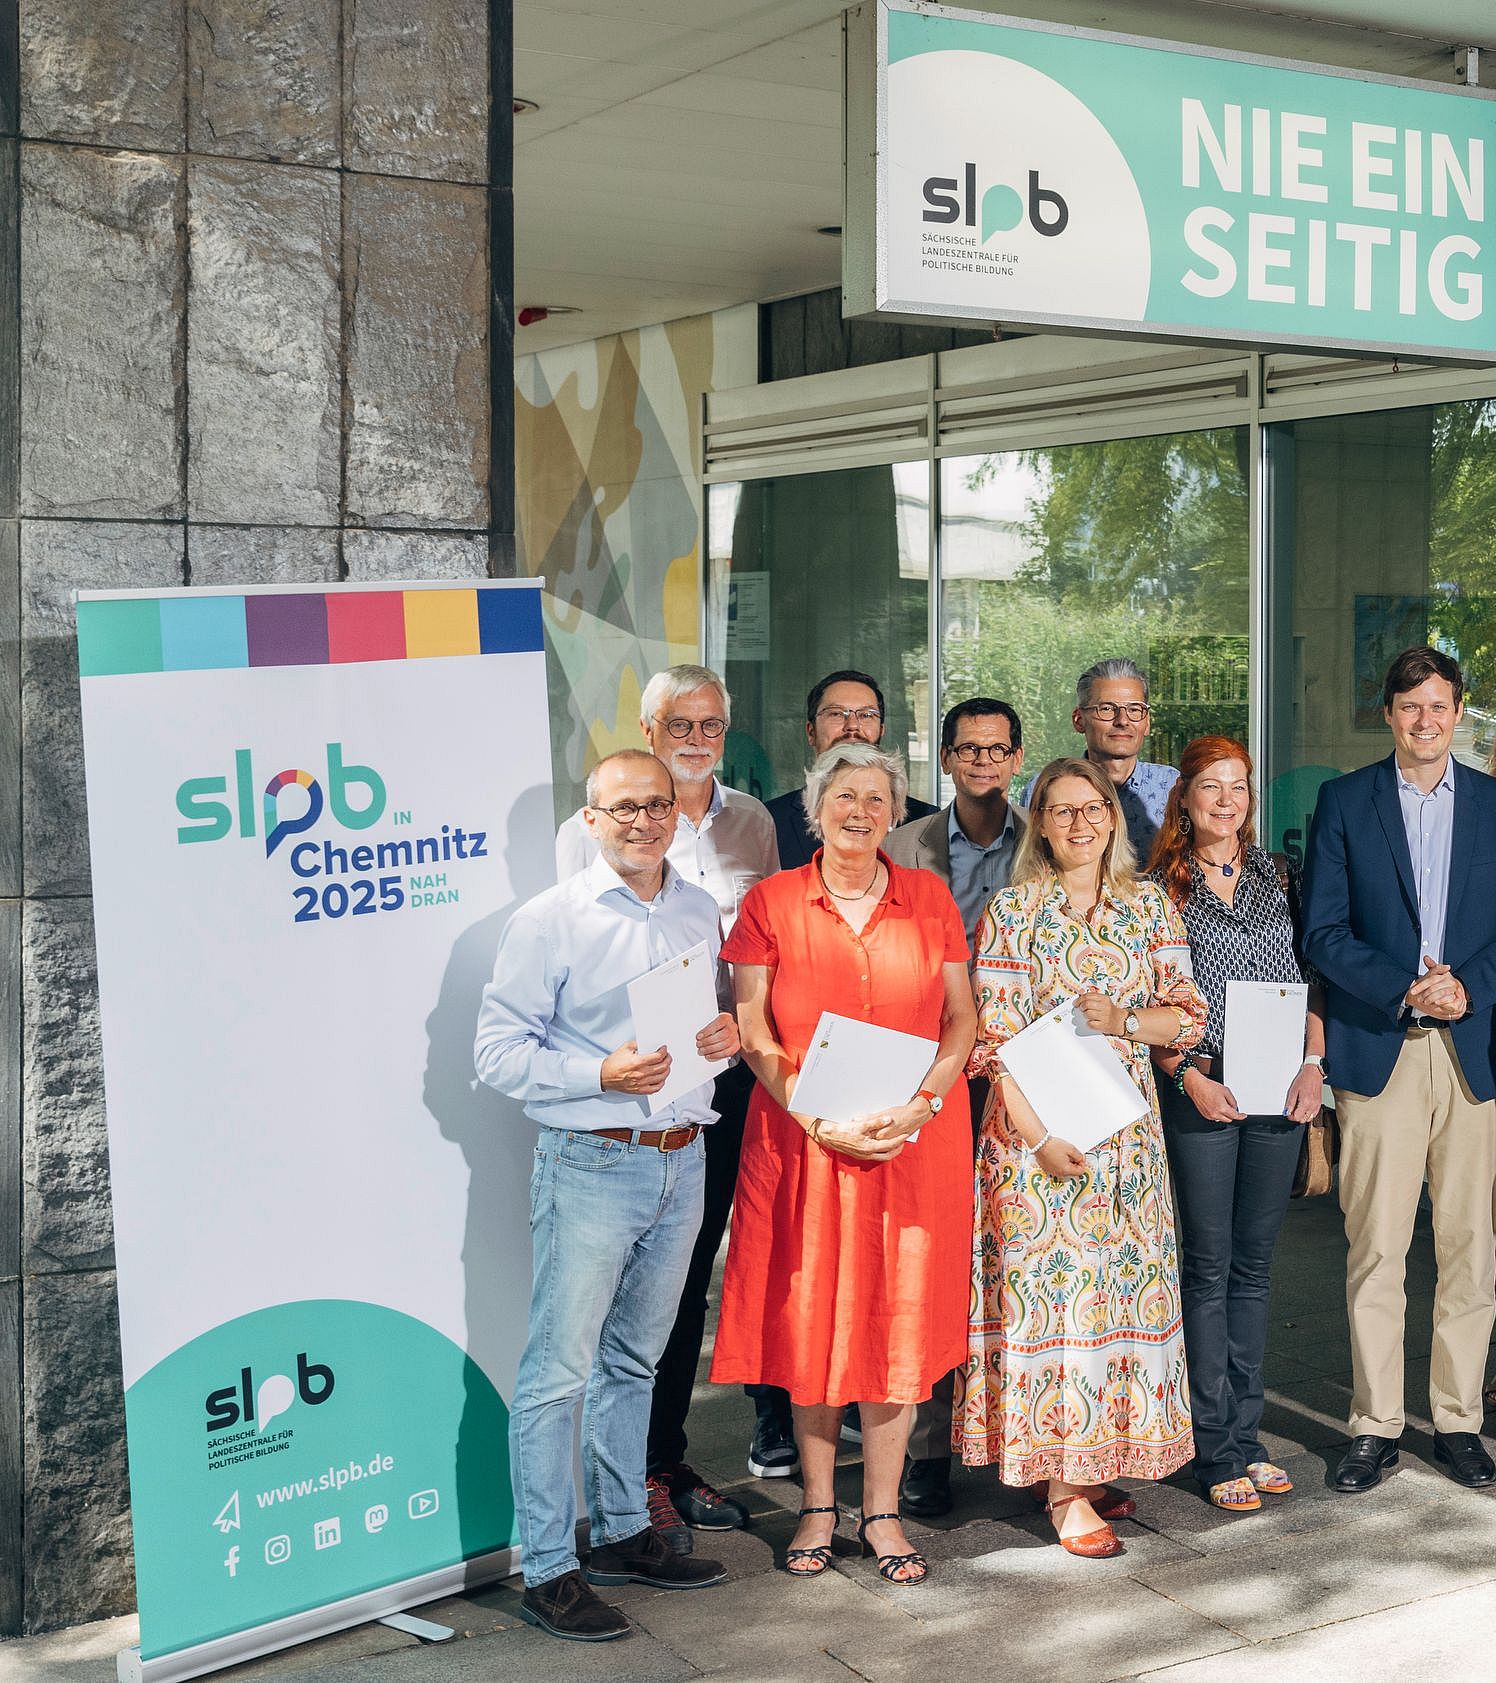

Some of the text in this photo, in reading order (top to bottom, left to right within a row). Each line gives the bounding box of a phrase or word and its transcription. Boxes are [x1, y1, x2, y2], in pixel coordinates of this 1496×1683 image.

[1182, 98, 1484, 222] NIE EIN
[923, 162, 1069, 245] slpb
[922, 233, 977, 247] SÄCHSISCHE
[922, 246, 1019, 264] LANDESZENTRALE FÜR
[922, 259, 1014, 276] POLITISCHE BILDUNG
[1180, 207, 1483, 321] SEITIG
[175, 742, 412, 859] slpb IN
[290, 824, 488, 878] Chemnitz
[293, 875, 405, 923] 2025
[410, 872, 448, 890] NAH
[411, 888, 460, 909] DRAN
[205, 1352, 335, 1433] slpb
[207, 1429, 256, 1449] SÄCHSISCHE
[208, 1429, 294, 1460] LANDESZENTRALE FÜR
[208, 1441, 290, 1471] POLITISCHE BILDUNG
[256, 1453, 395, 1509] www.slpb.de
